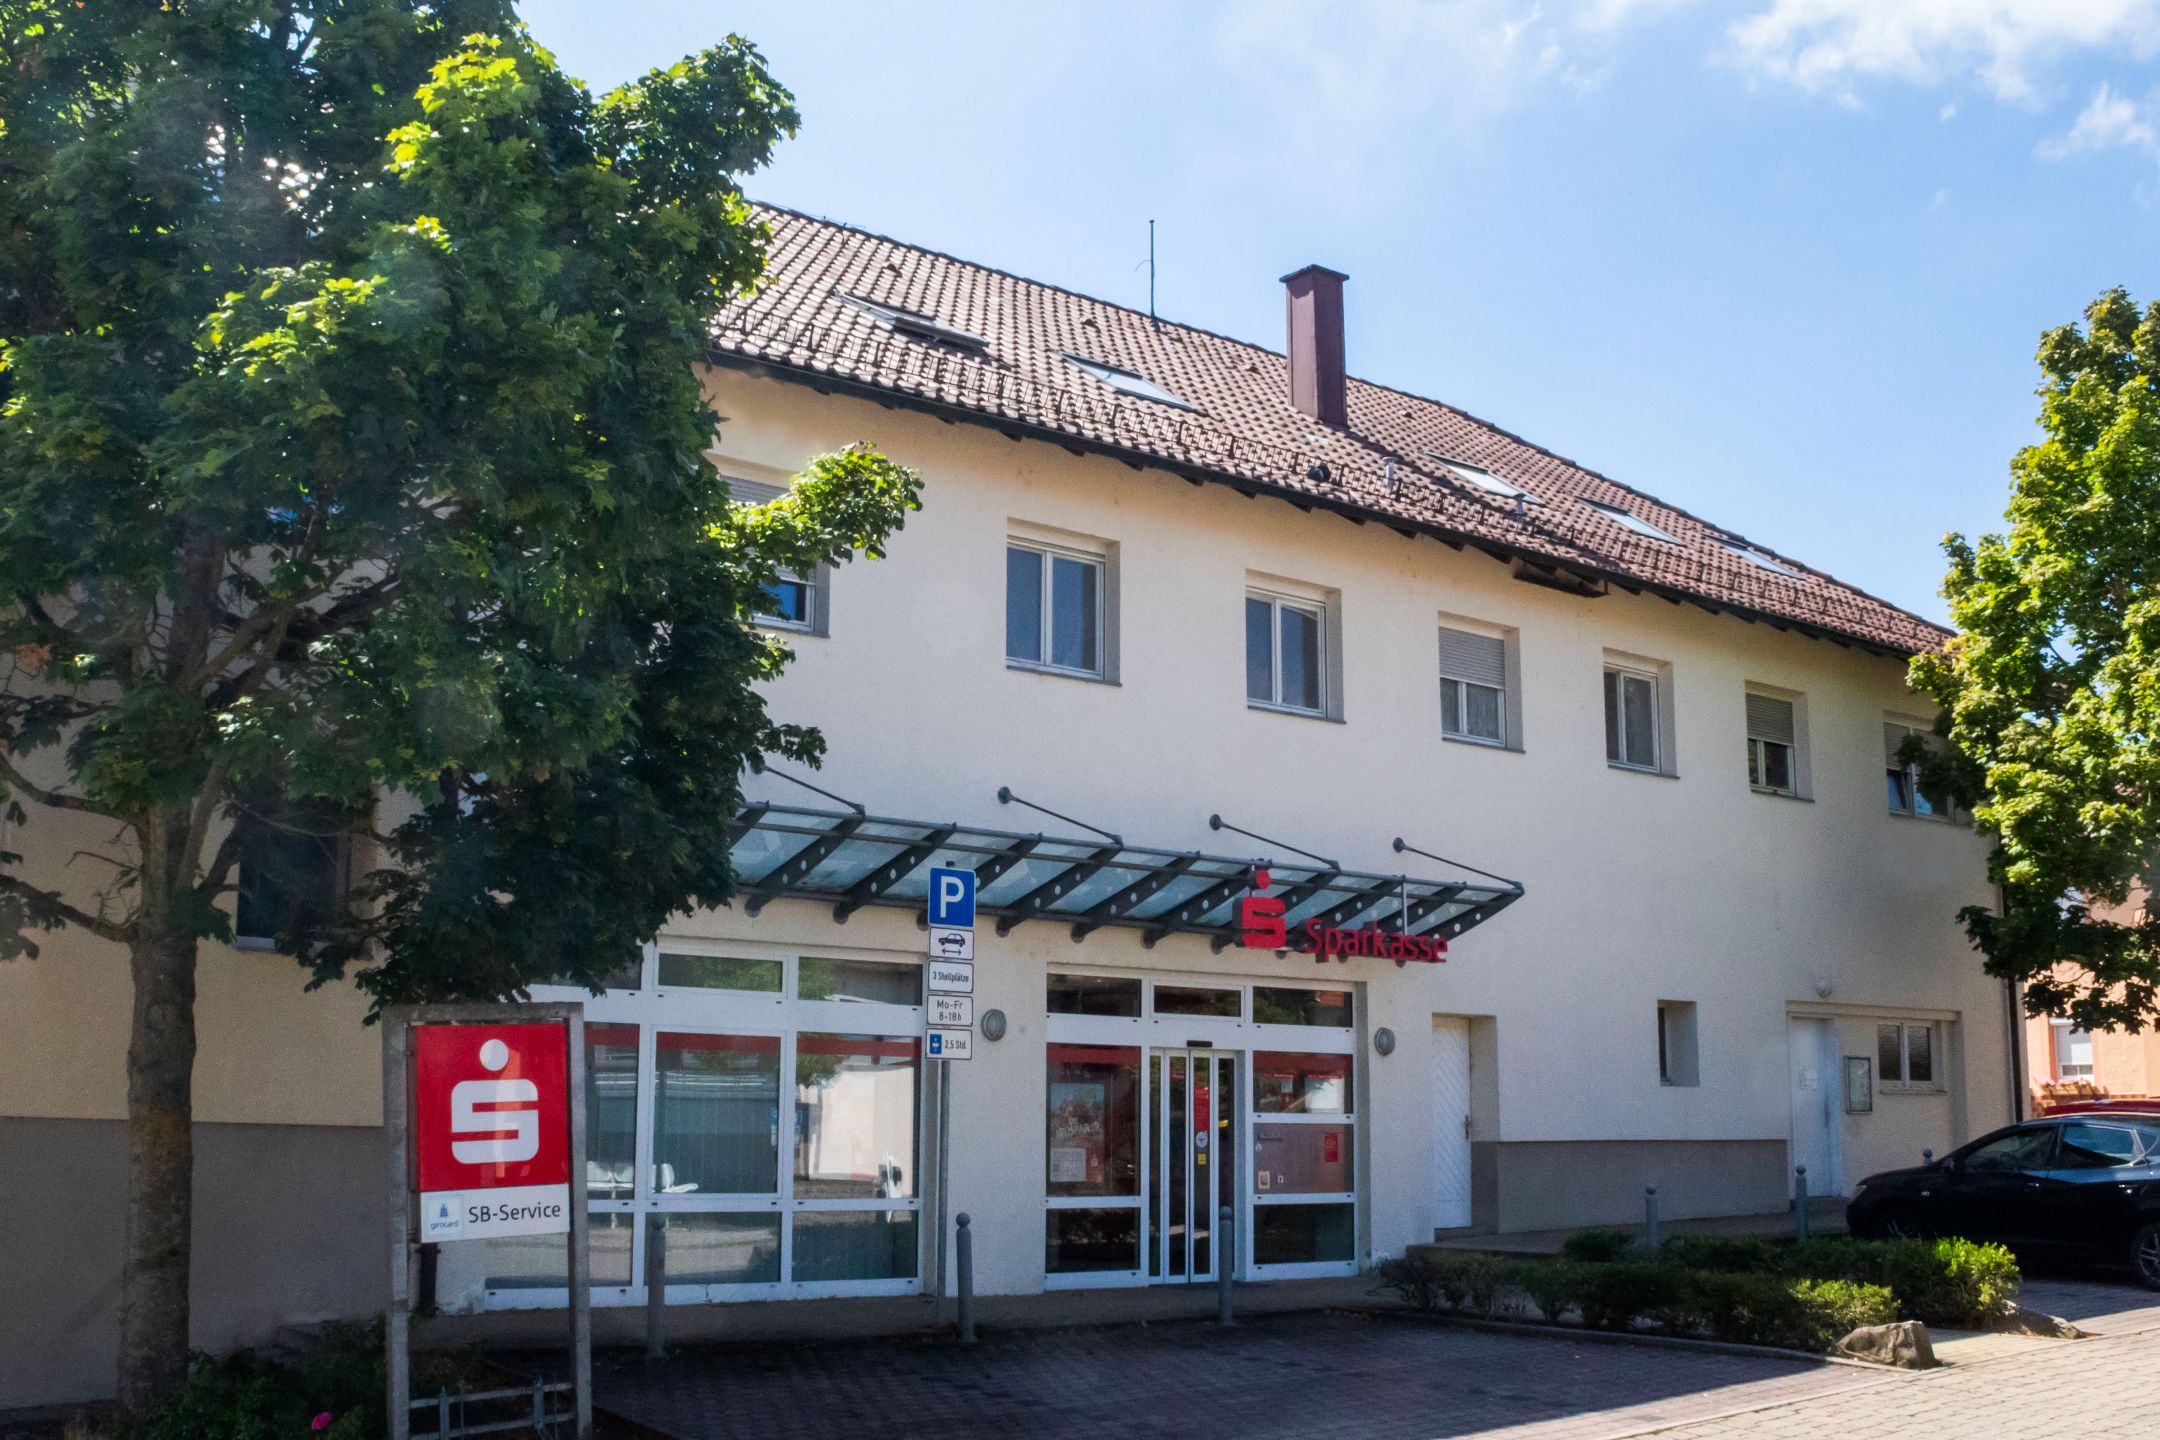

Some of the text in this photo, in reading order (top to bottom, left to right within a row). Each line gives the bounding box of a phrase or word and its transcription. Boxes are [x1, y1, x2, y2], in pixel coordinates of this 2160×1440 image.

[940, 875, 964, 918] P
[1305, 917, 1448, 963] Sparkasse
[936, 1000, 963, 1010] Mo-Fr
[468, 1201, 561, 1223] SB-Service
